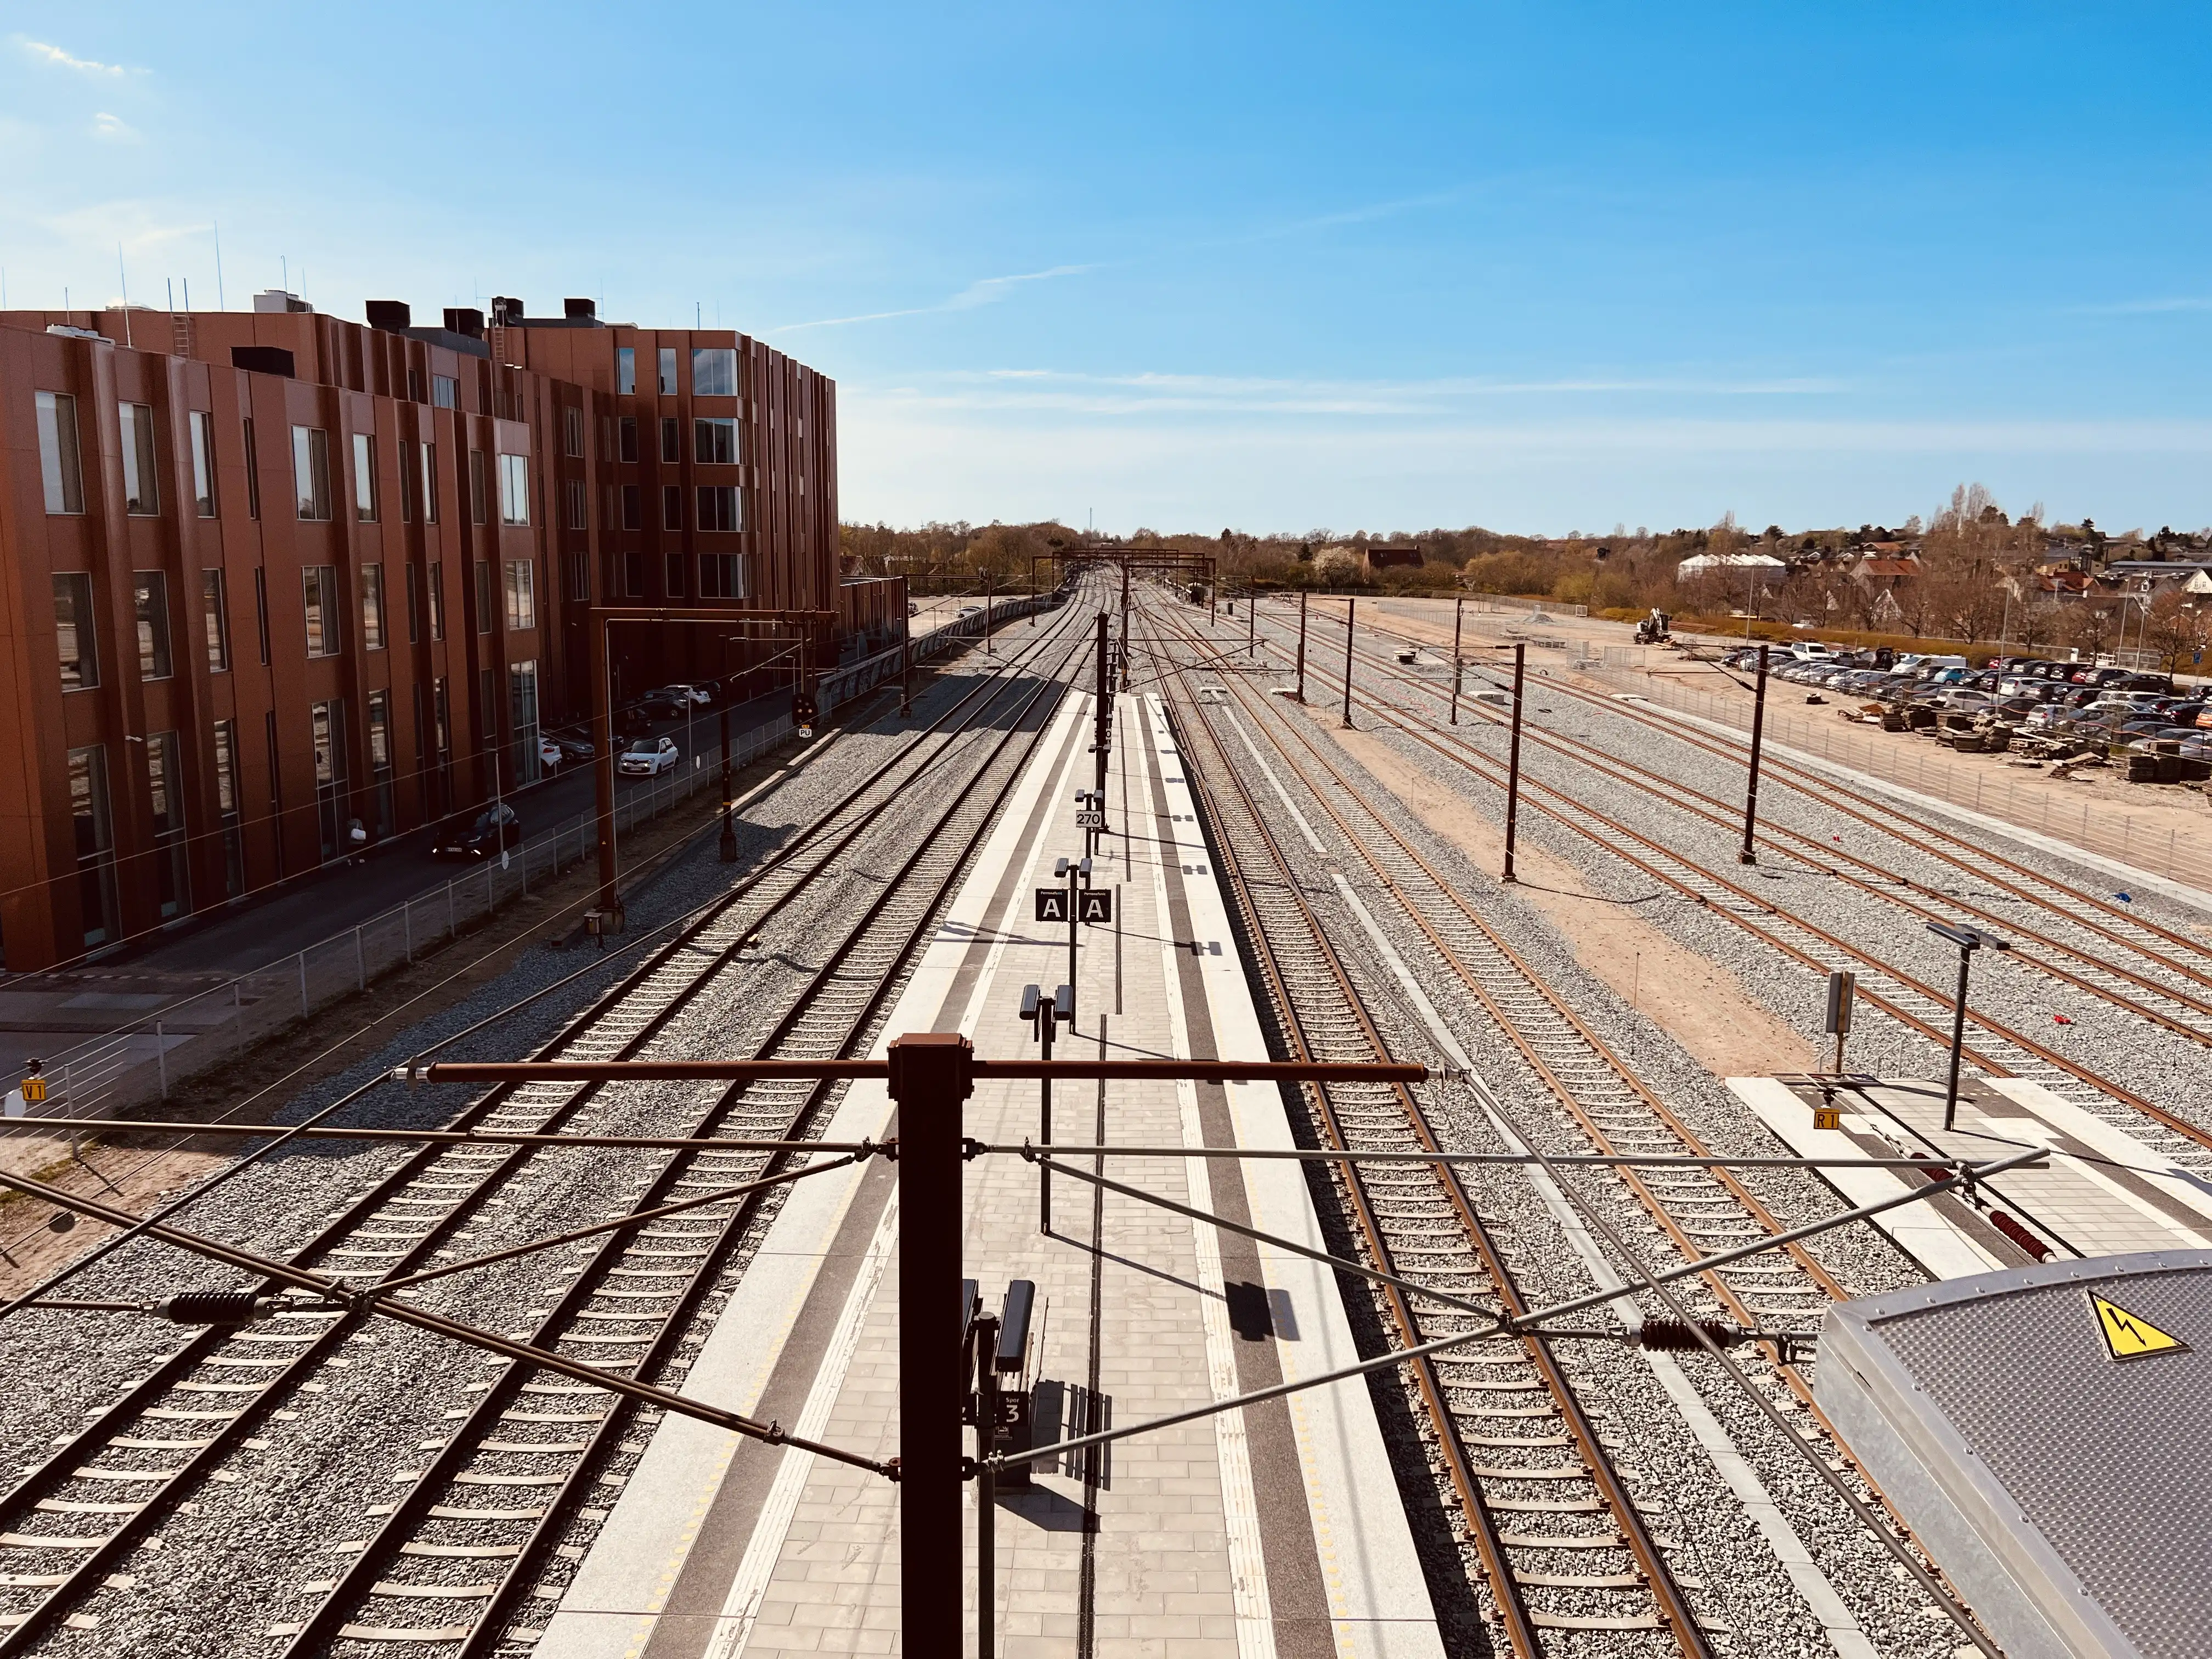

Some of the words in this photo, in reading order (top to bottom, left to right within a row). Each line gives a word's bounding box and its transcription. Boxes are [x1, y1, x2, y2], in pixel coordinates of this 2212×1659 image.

[1076, 814, 1101, 824] 270
[1043, 899, 1060, 917] A
[1086, 899, 1103, 917] A
[1006, 1404, 1019, 1423] 3
